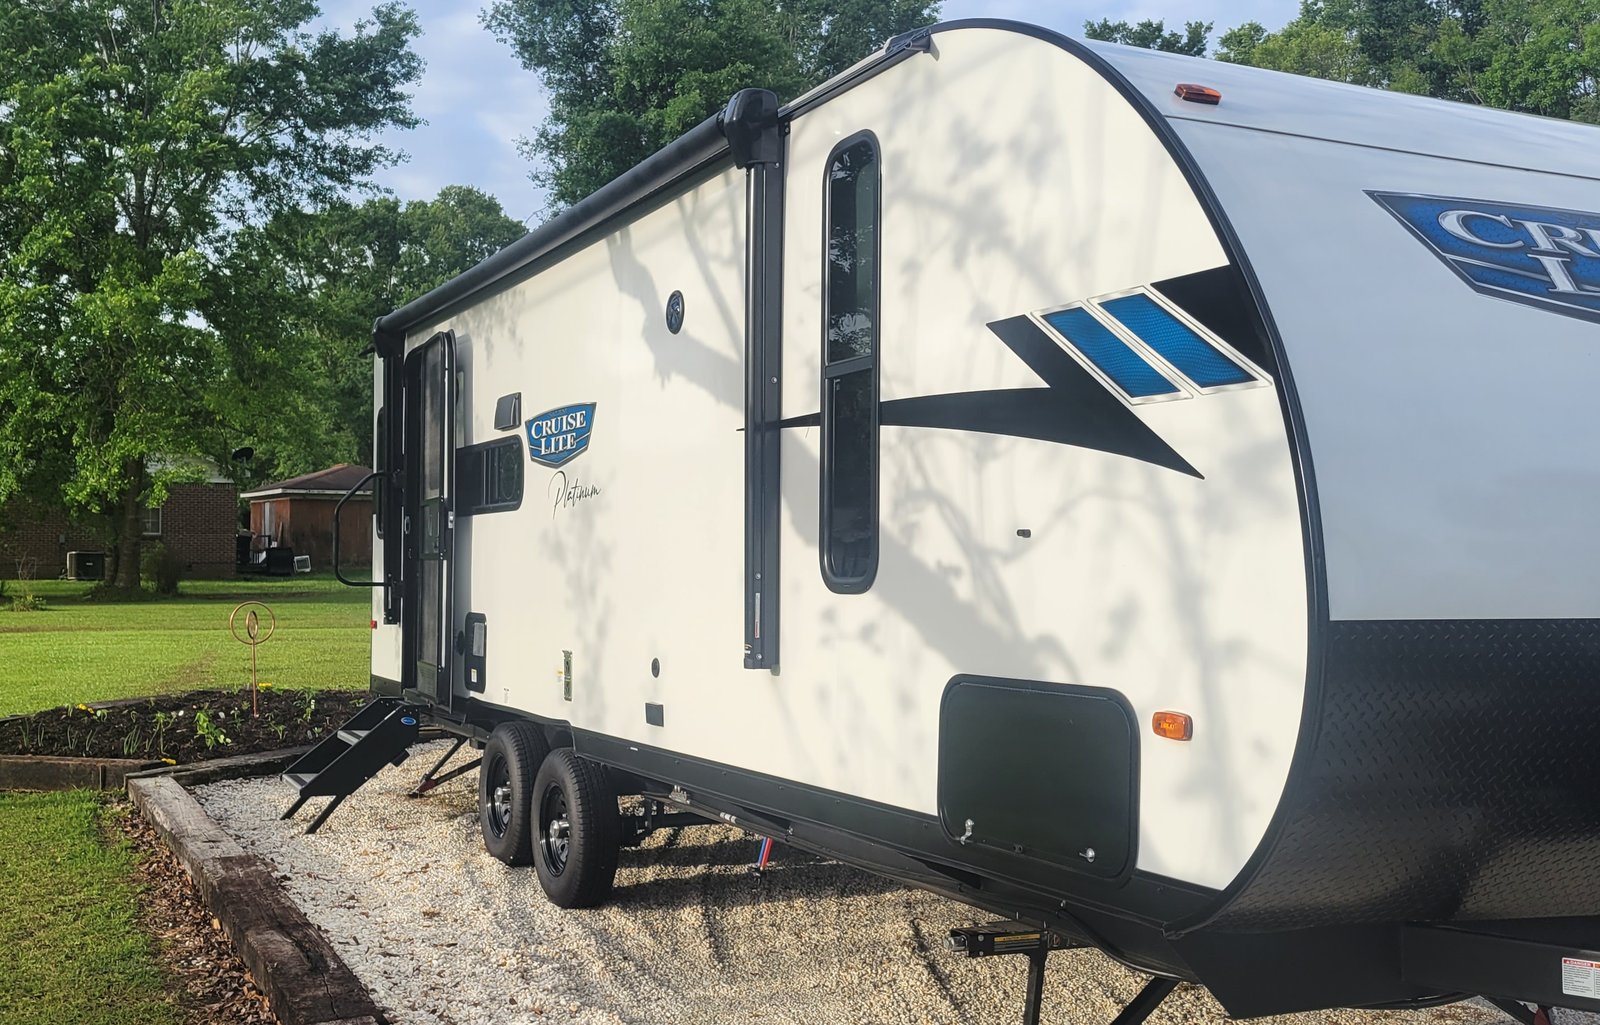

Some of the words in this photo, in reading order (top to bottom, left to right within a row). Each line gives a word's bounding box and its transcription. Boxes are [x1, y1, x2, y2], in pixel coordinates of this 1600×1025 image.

[531, 410, 586, 440] CRUISE
[540, 432, 577, 455] LITE
[548, 470, 601, 520] Platinum
